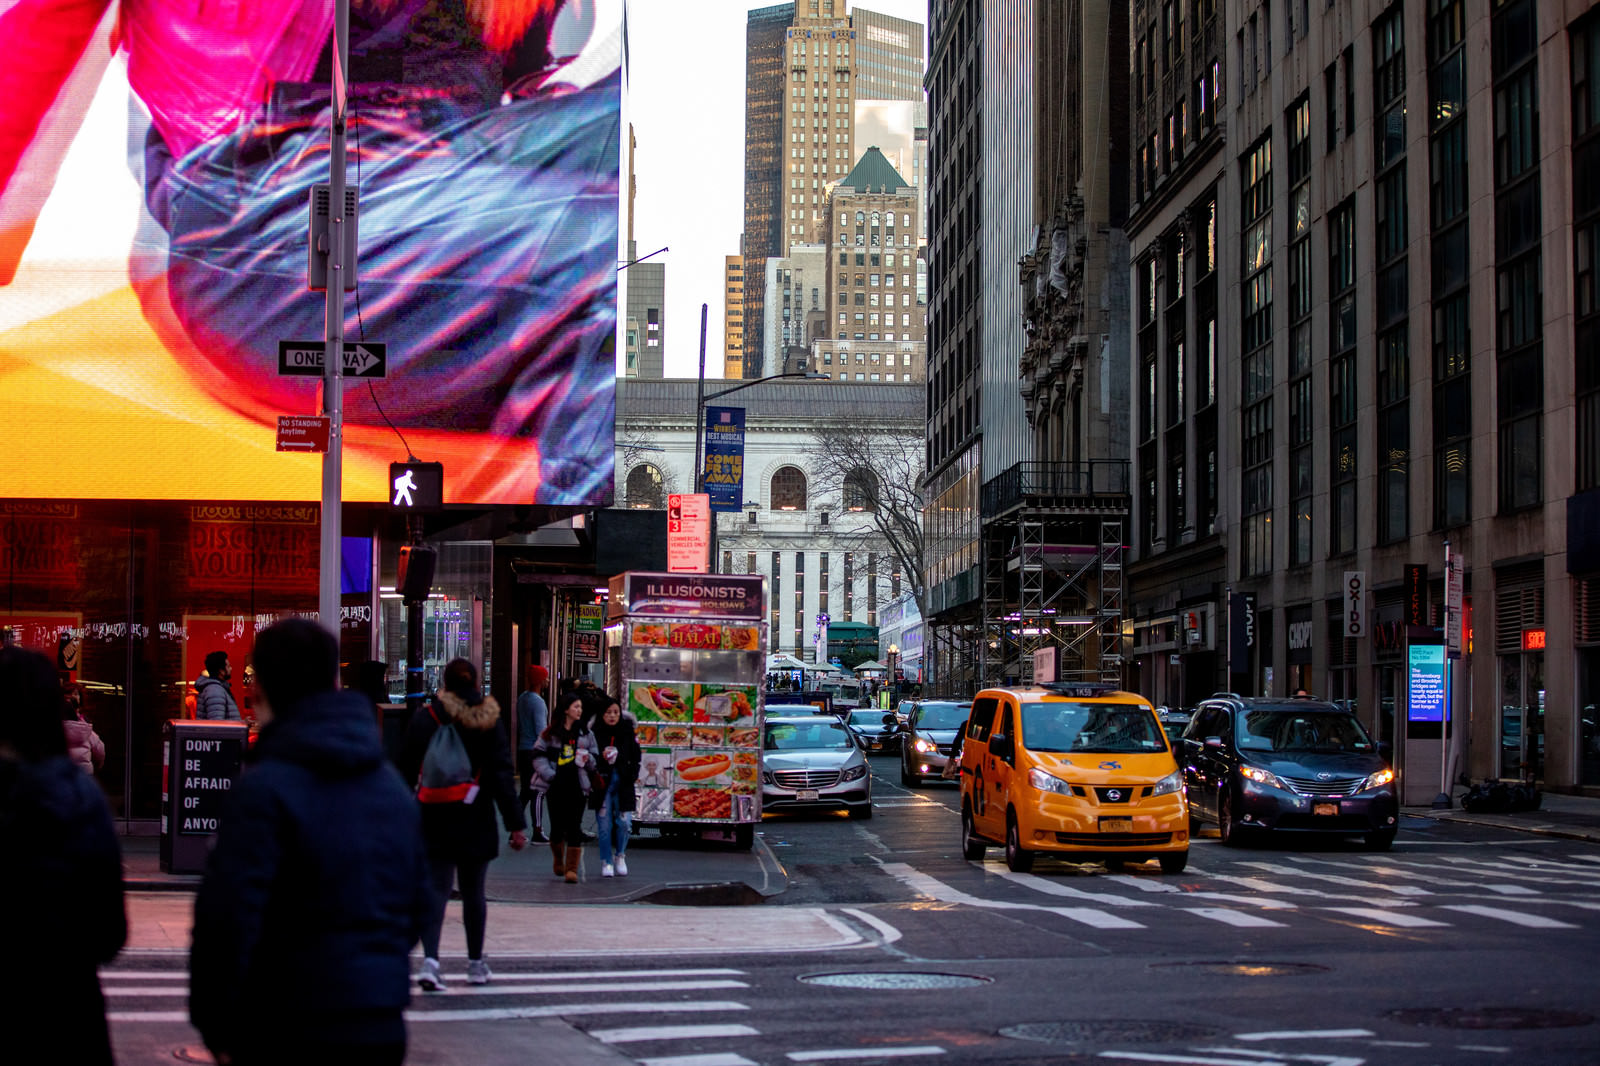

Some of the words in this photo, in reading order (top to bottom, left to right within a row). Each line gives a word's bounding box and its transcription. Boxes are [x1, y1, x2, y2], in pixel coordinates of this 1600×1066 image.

[294, 352, 325, 366] ONE
[342, 353, 370, 367] WAY
[291, 420, 322, 428] STANDING
[280, 428, 306, 436] Anytime
[706, 454, 743, 465] COME
[705, 473, 742, 485] AWAY
[672, 521, 680, 532] 3
[647, 583, 747, 599] ILLUSIONISTS
[702, 600, 746, 610] HOLIDAYS
[673, 632, 721, 647] HALAL
[185, 740, 223, 752] DON'T
[185, 759, 201, 772] BE
[184, 777, 232, 791] AFRAID
[184, 796, 200, 809] OF
[183, 817, 222, 831] ANYO
